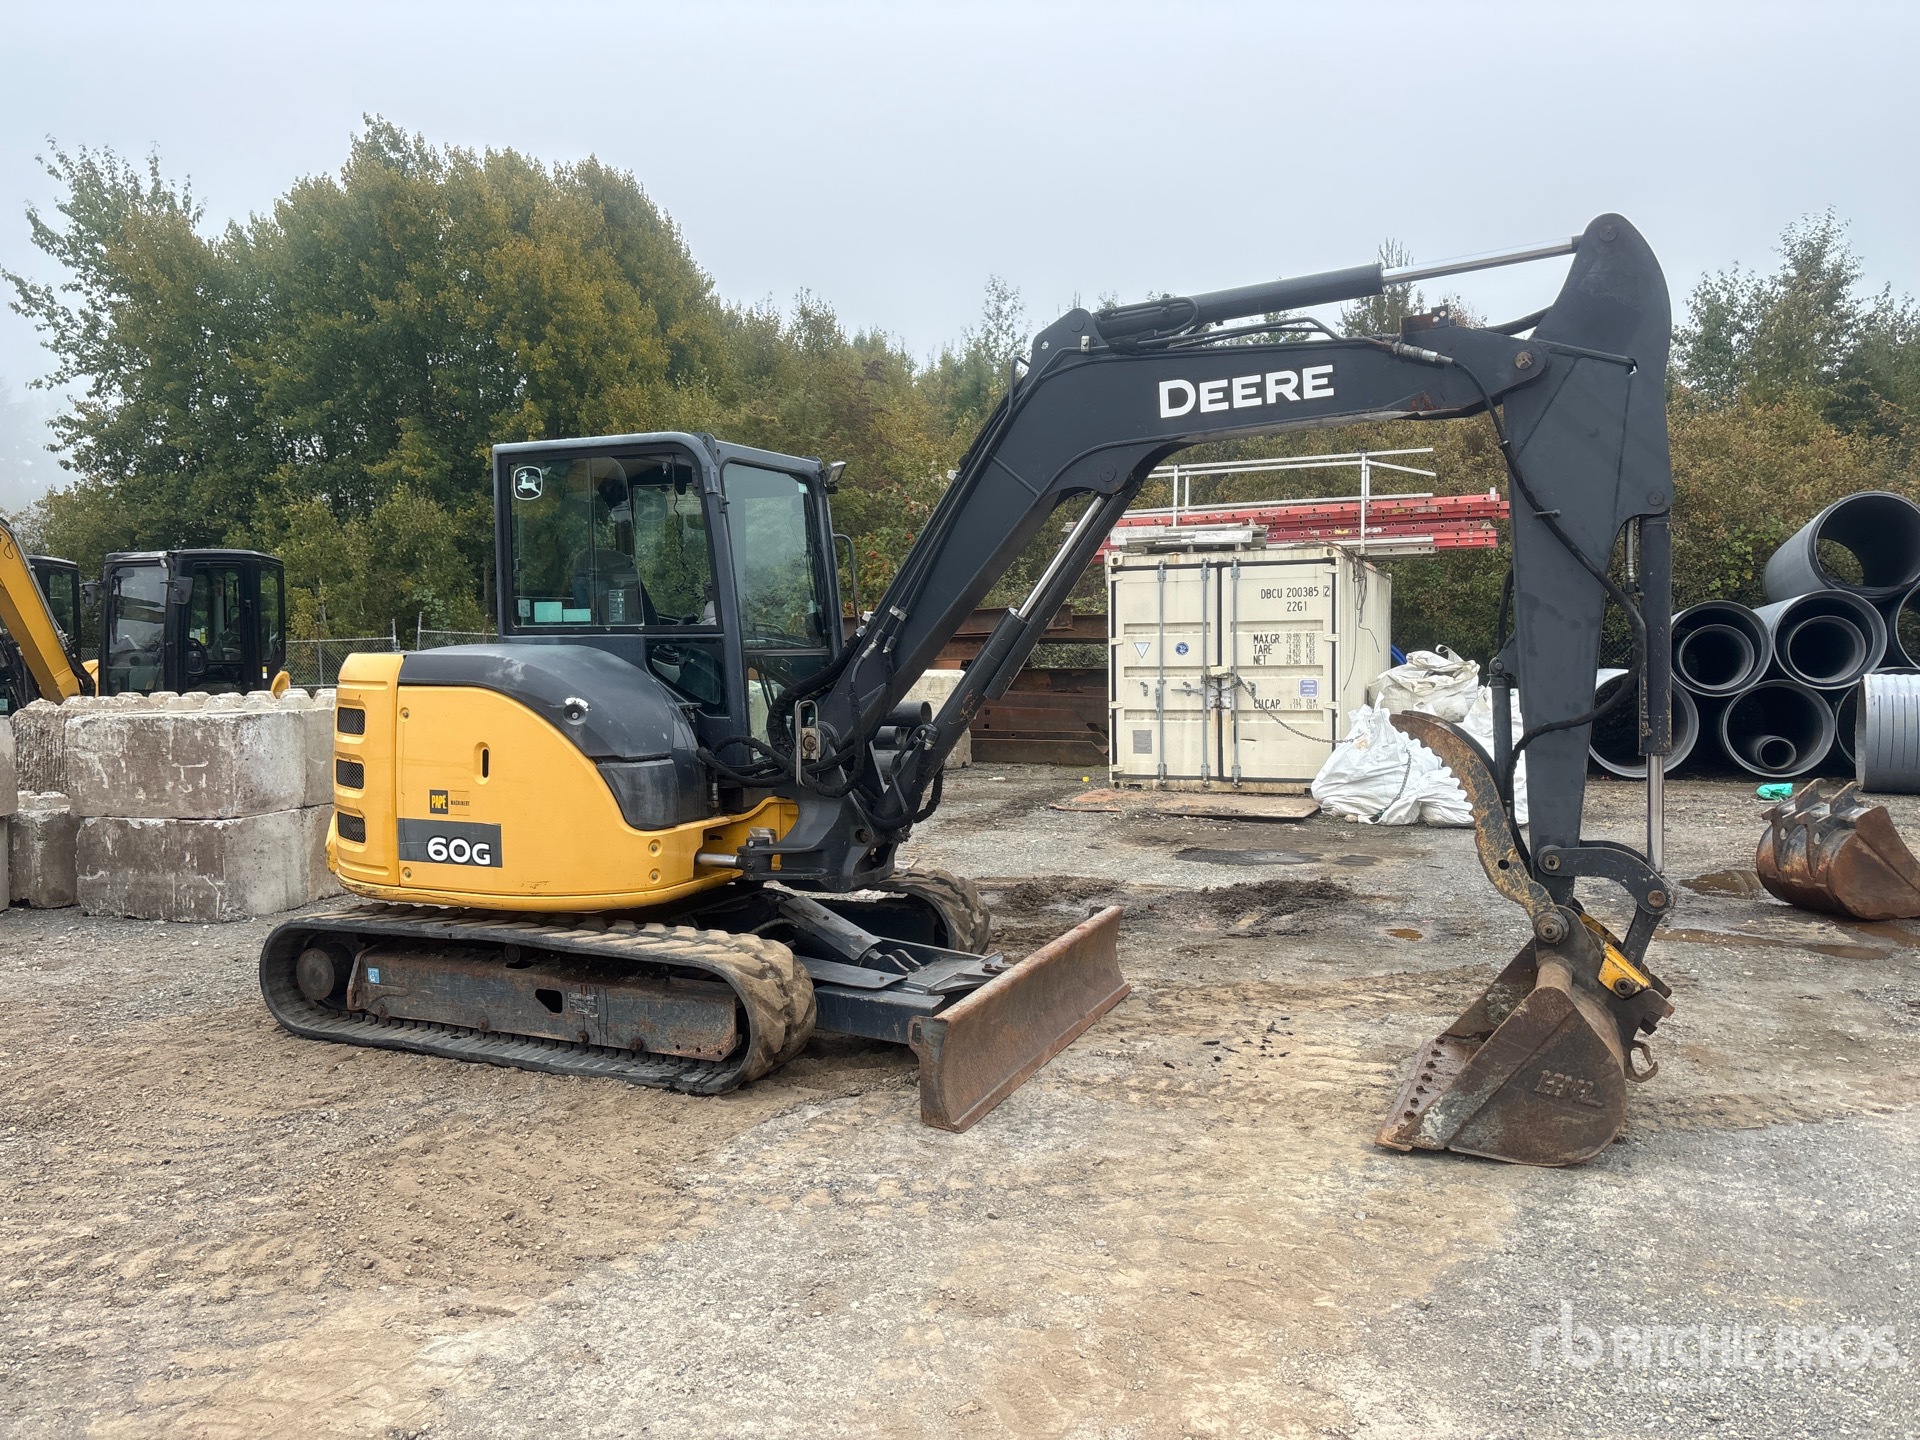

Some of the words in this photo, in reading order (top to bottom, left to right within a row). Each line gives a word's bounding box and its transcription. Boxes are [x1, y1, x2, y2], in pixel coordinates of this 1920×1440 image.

[1159, 364, 1335, 418] DEERE
[1260, 588, 1283, 600] DBCU
[1286, 586, 1319, 598] 200385
[1324, 585, 1330, 597] 2
[1286, 601, 1307, 612] 22G1
[1253, 644, 1273, 655] TARE
[1253, 655, 1267, 665] NET
[426, 836, 492, 866] 60G
